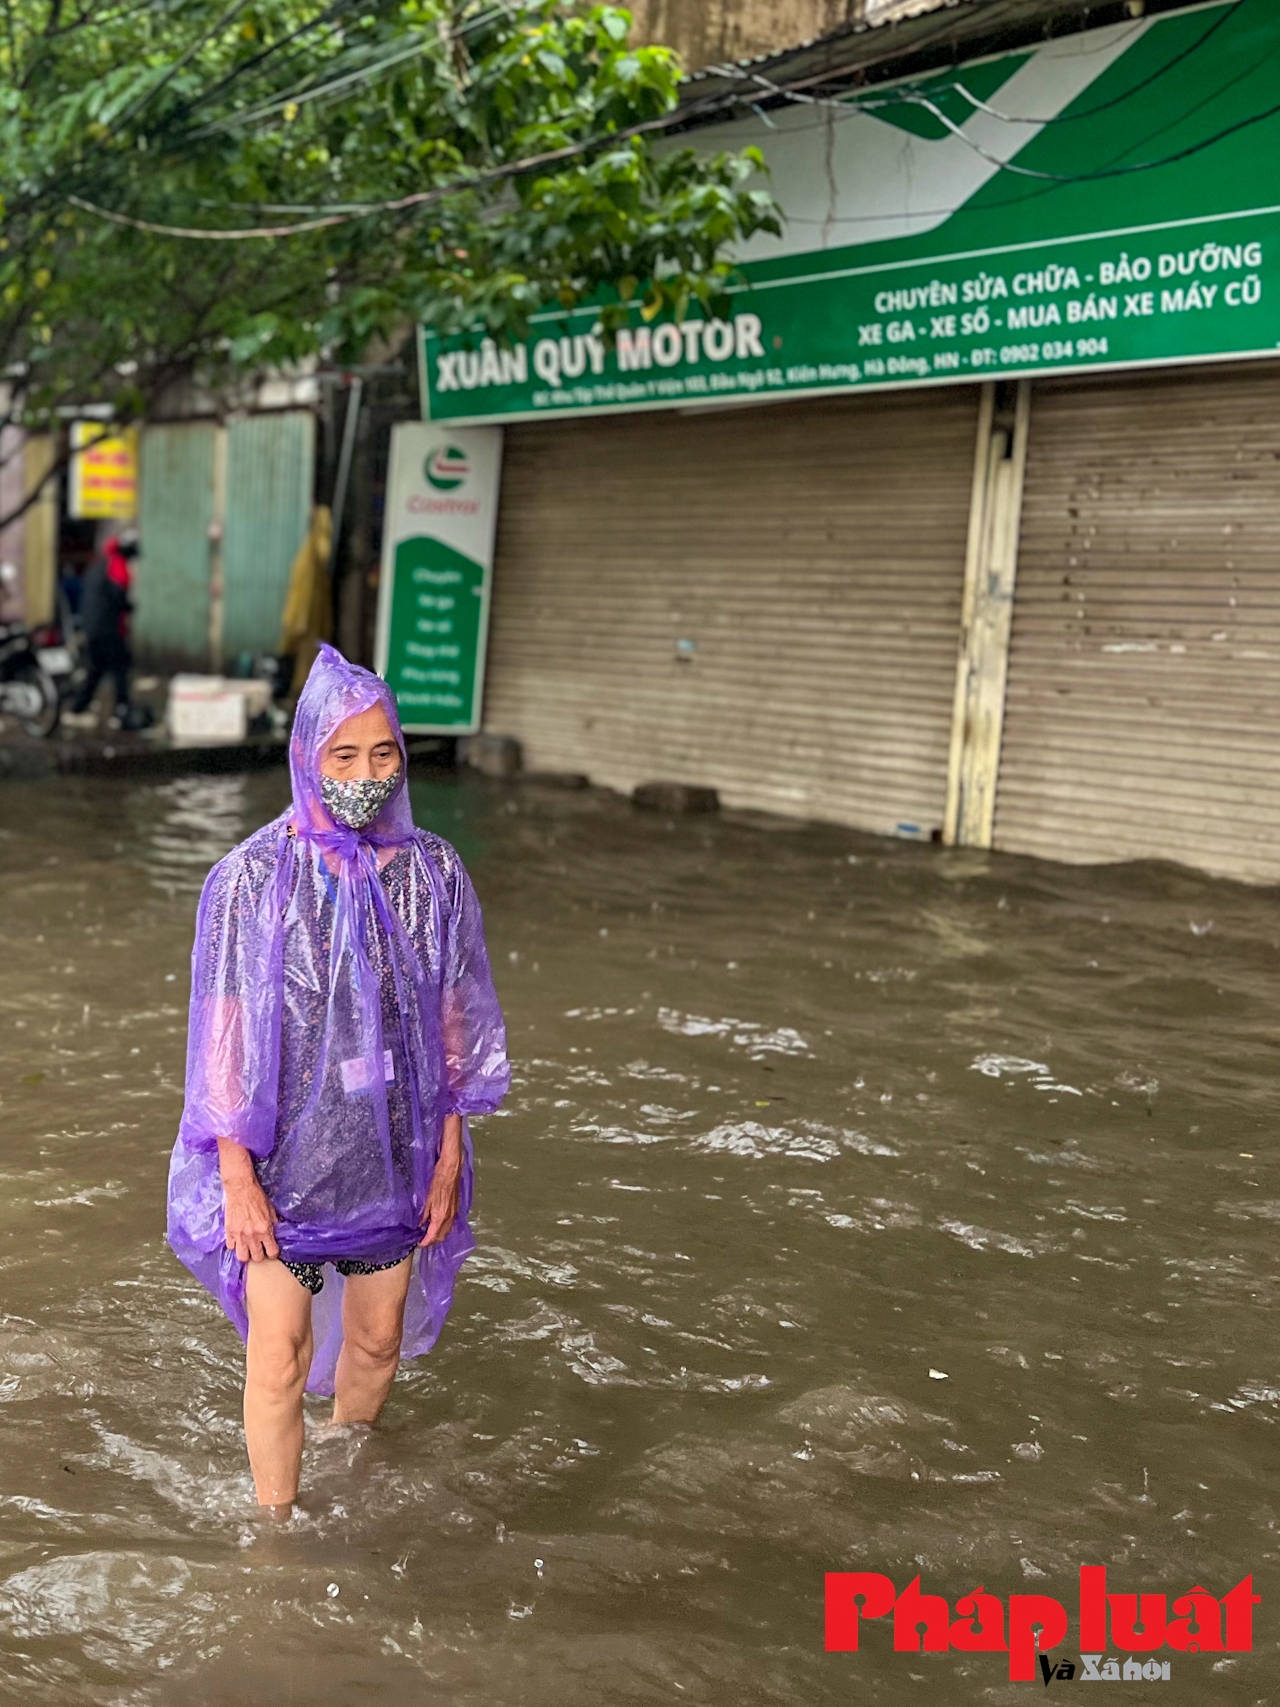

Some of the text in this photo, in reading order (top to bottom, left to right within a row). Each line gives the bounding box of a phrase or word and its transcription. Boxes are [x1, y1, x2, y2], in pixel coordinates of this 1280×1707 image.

[858, 323, 883, 346] XE
[886, 320, 916, 343] GA
[930, 315, 956, 338] XE
[960, 305, 990, 336] SỐ
[1007, 303, 1061, 330] MUA
[1066, 292, 1117, 324] BÁN
[1123, 292, 1154, 317] XE
[1161, 280, 1218, 314] MÁY
[1224, 274, 1261, 306] CŨ
[874, 280, 958, 314] CHUYÊN
[962, 272, 1008, 303] SỬA
[1012, 264, 1080, 296] CHỮA
[1099, 252, 1152, 286] BẢO
[1158, 242, 1262, 278] DƯỠNG
[436, 314, 765, 392] XUÂN QUÝ MOTOR
[933, 351, 960, 370] HN
[971, 347, 997, 366] ĐT:
[999, 344, 1040, 364] 0902
[1041, 340, 1073, 361] 034
[1075, 337, 1108, 357] 904
